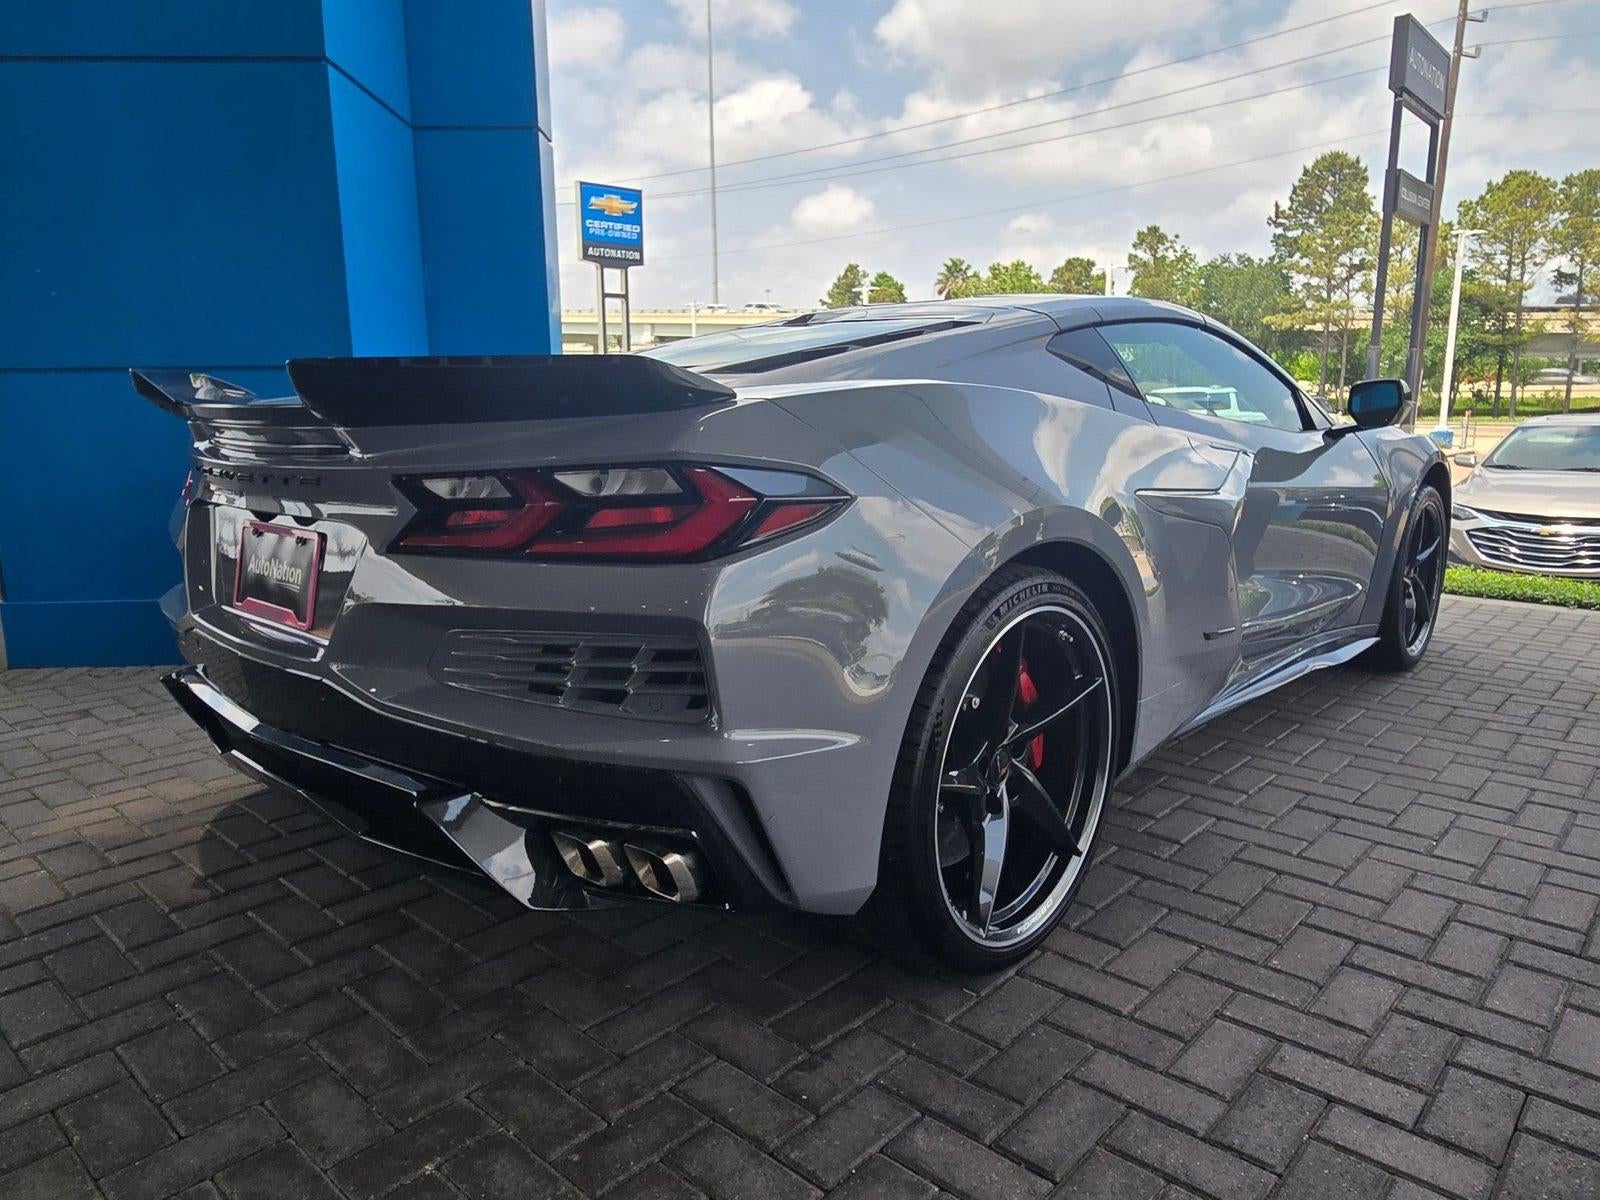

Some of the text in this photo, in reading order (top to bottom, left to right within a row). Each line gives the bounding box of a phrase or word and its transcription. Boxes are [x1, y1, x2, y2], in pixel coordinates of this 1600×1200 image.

[585, 219, 641, 233] CERTIFIED
[588, 227, 638, 240] PRE-OWNED
[587, 246, 640, 260] AUTONATION
[247, 553, 302, 585] AutoNation
[999, 583, 1049, 616] MICHELIN
